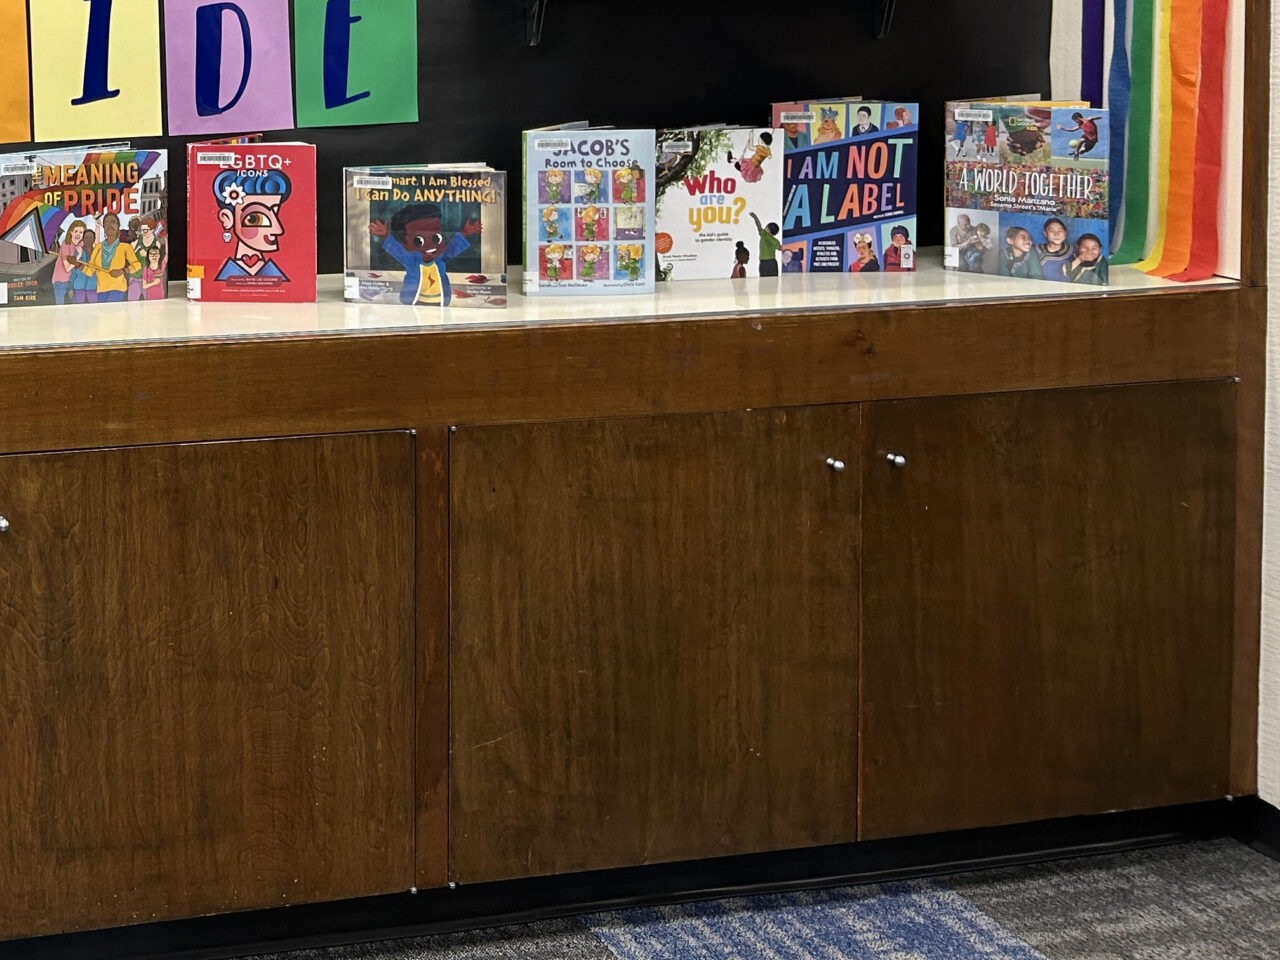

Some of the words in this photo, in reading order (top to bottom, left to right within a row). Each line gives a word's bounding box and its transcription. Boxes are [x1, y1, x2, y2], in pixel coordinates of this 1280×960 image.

[544, 158, 577, 169] Room
[581, 158, 593, 169] to
[596, 158, 639, 168] Choose
[787, 158, 793, 179] I
[798, 151, 839, 180] AM
[846, 138, 914, 180] NOT
[44, 162, 139, 186] MEANING
[236, 169, 269, 178] ICONS
[390, 176, 419, 187] mart,
[421, 175, 426, 186] I
[429, 176, 447, 186] Am
[959, 167, 969, 192] A
[974, 168, 1018, 194] WORLD
[1022, 171, 1094, 200] TOGETHER
[44, 191, 62, 206] OF
[63, 188, 140, 216] PRIDE
[355, 187, 360, 200] I
[364, 188, 389, 201] Can
[393, 187, 410, 201] Do
[414, 188, 497, 204] ANYTHING!
[699, 194, 725, 206] are
[994, 194, 1016, 204] Sonia
[1017, 196, 1056, 207] Manzano
[688, 196, 747, 233] you?
[783, 183, 812, 231] A
[820, 182, 905, 224] LABEL
